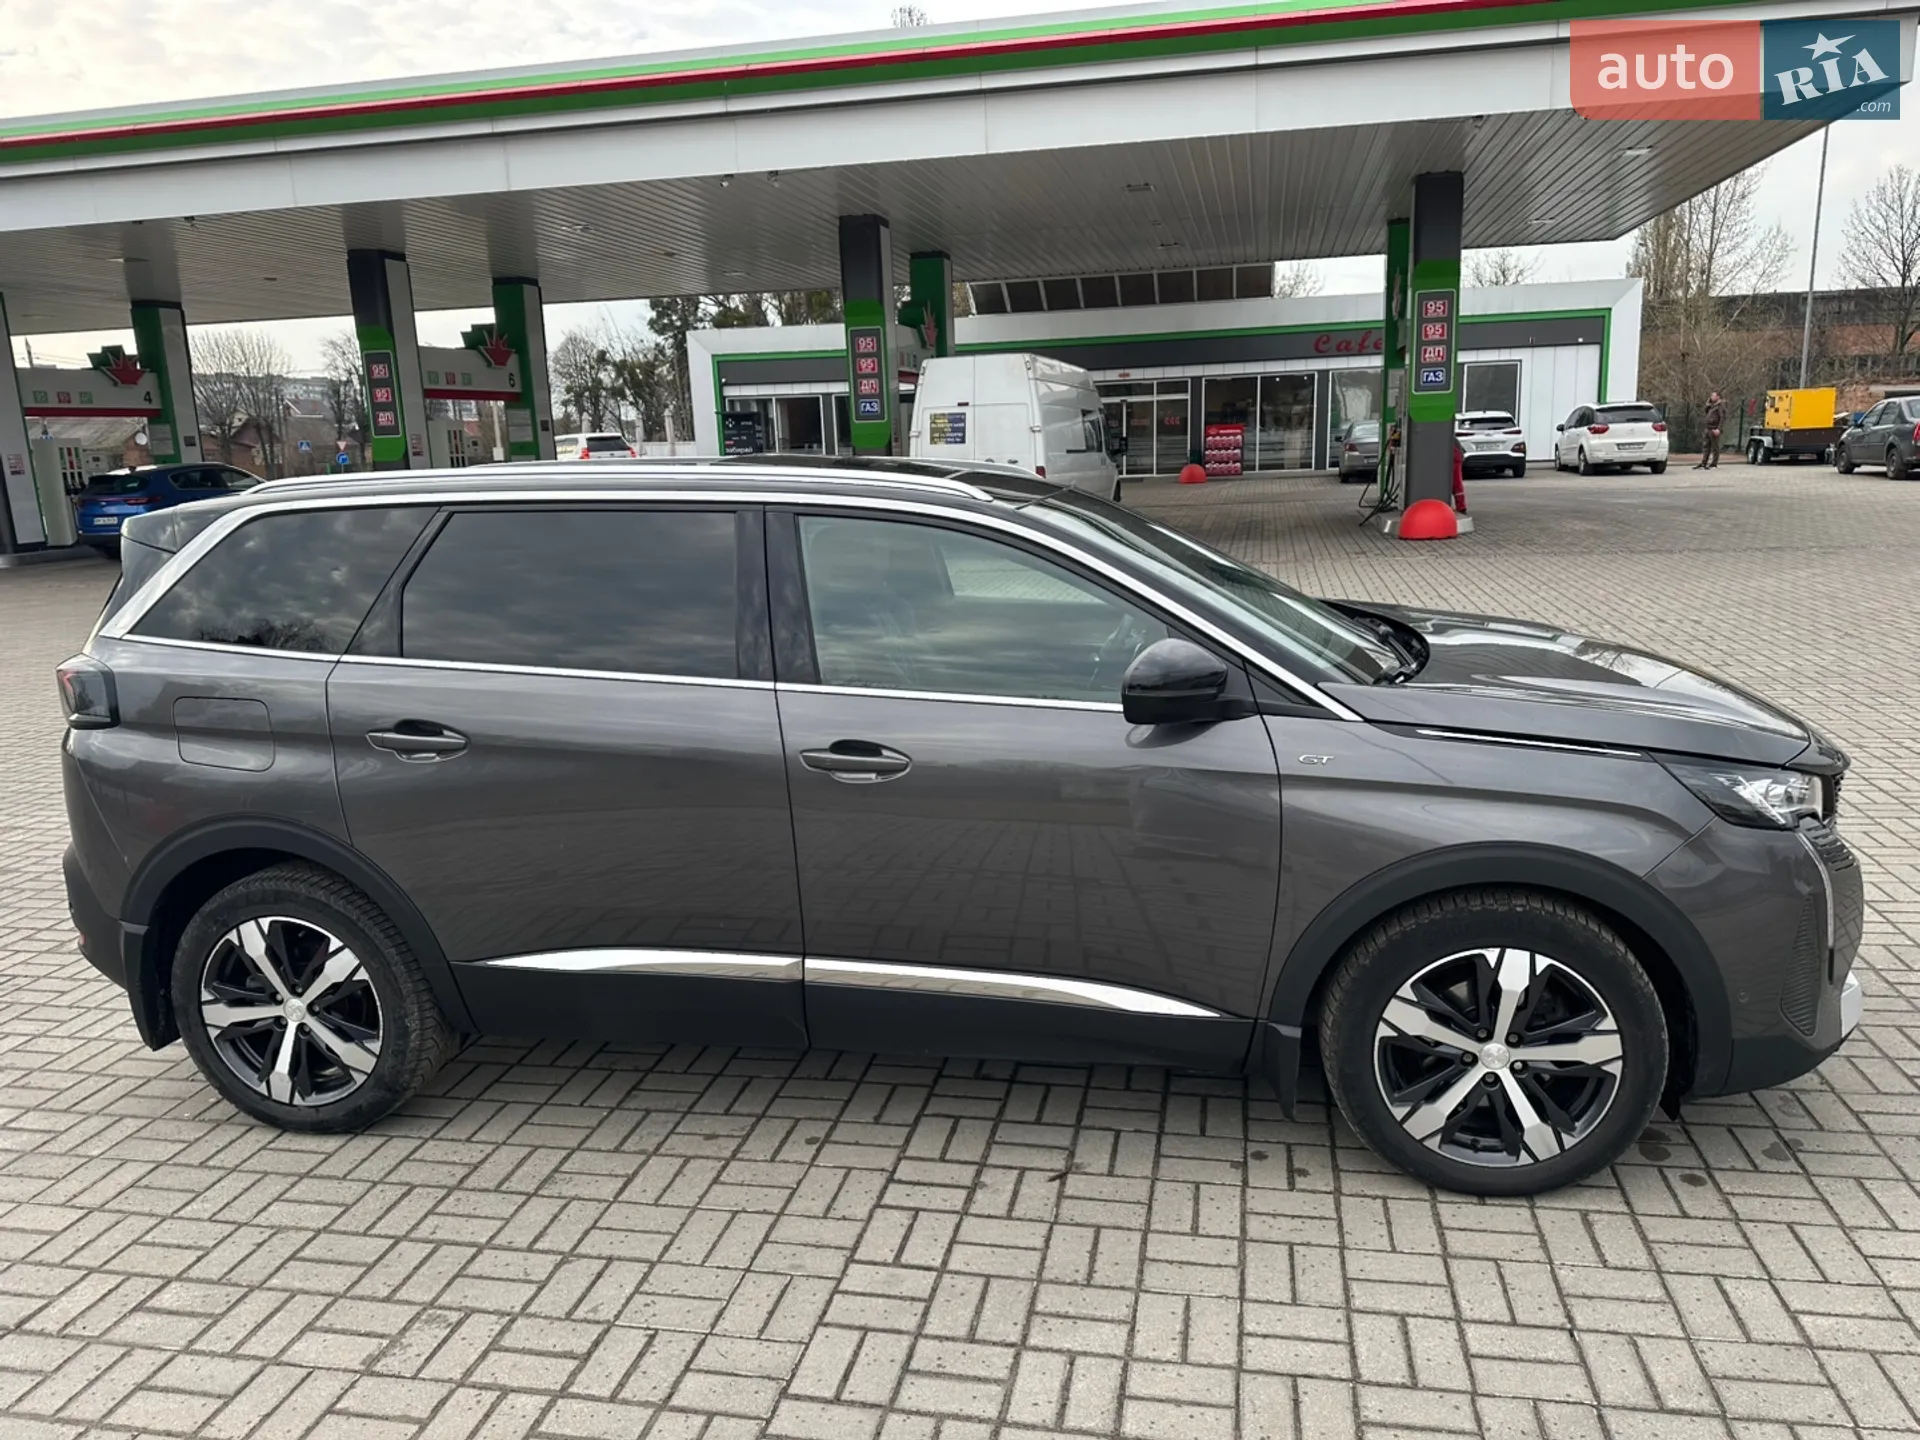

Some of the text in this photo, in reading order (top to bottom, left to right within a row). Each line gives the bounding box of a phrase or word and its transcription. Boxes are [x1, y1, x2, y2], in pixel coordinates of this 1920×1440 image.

[1426, 301, 1444, 313] 95
[1426, 324, 1443, 335] 95
[858, 337, 874, 350] 95
[372, 365, 385, 375] 95
[859, 358, 874, 370] 95
[508, 372, 516, 388] 6
[1423, 371, 1444, 382] ГАЗ
[143, 391, 153, 404] 4
[375, 388, 388, 398] 95
[860, 401, 878, 412] ГАЗ
[1298, 754, 1335, 766] GT
